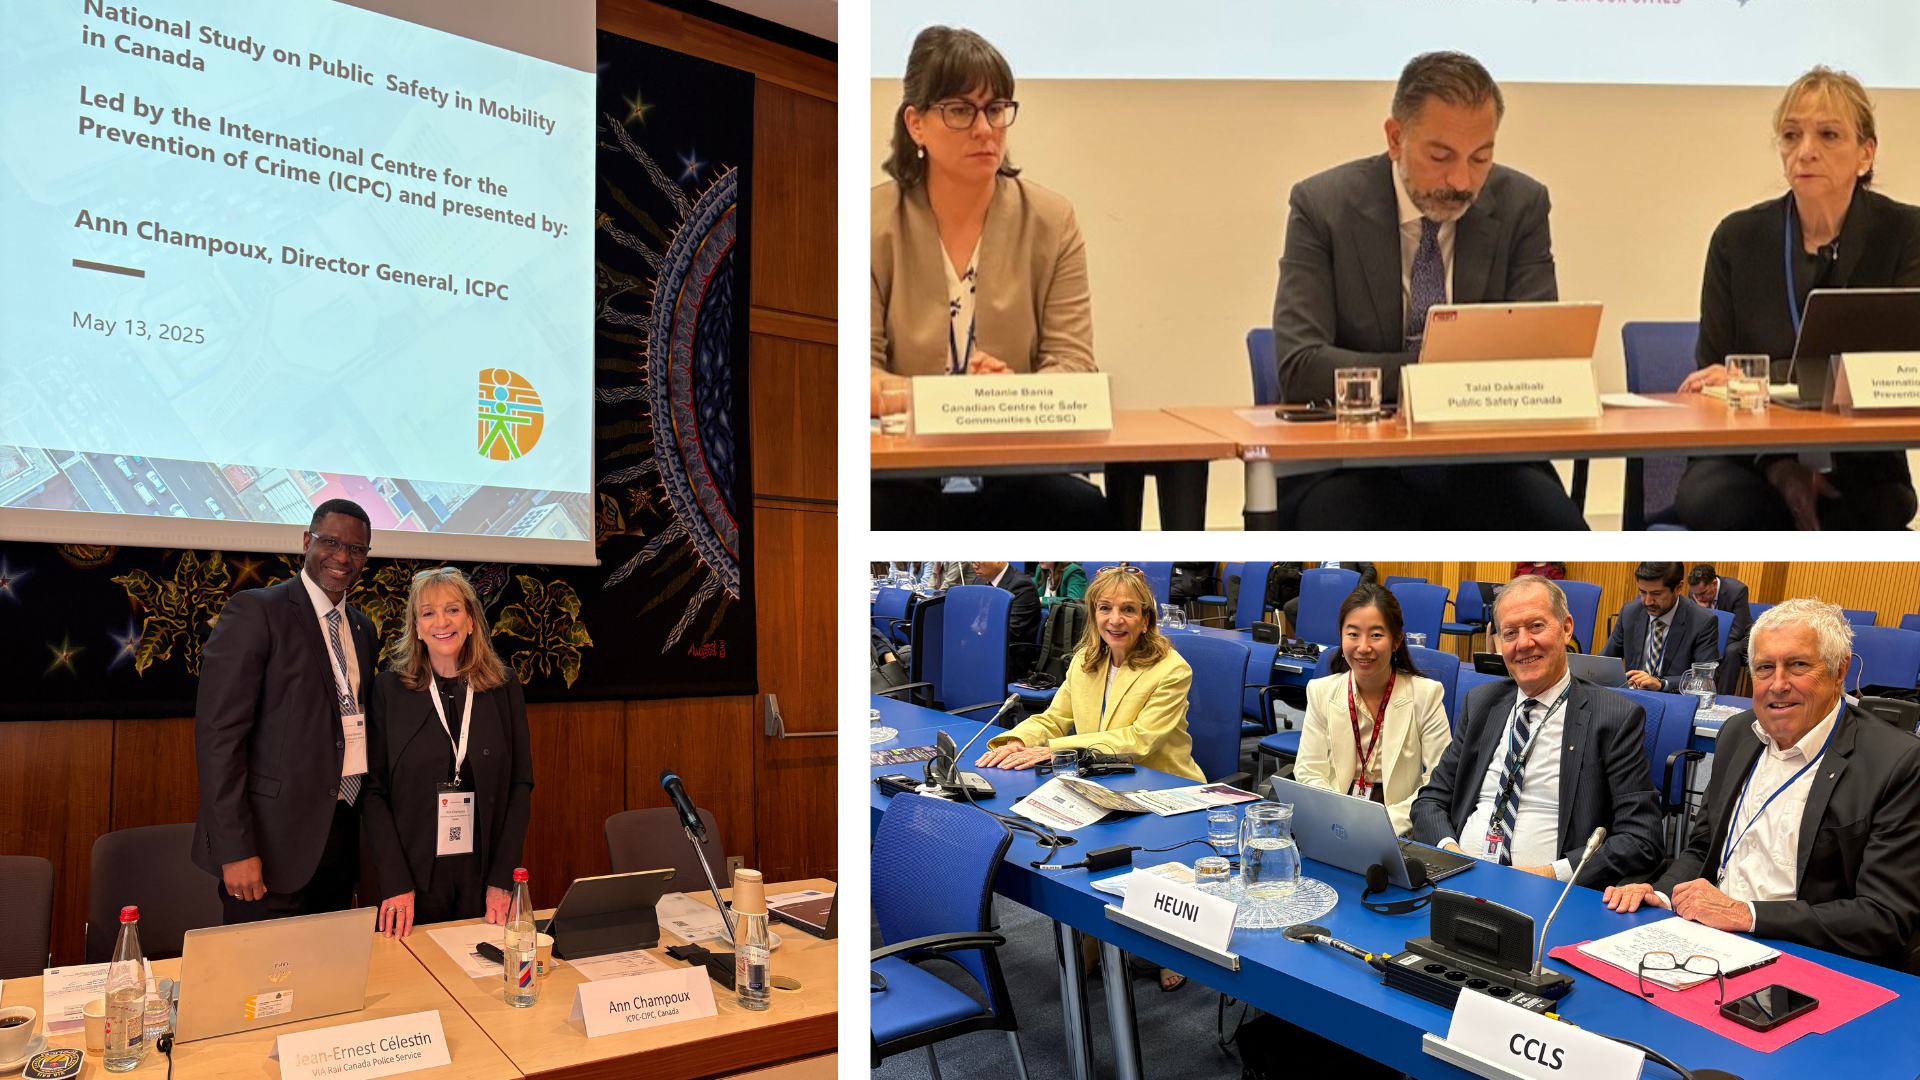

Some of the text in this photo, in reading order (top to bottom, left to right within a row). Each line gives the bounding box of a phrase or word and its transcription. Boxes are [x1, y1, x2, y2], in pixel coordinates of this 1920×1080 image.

[82, 25, 206, 72] in Canada
[83, 0, 556, 135] National Study on Public Safety in Mobility
[79, 85, 508, 198] Led by the International Centre for the
[78, 116, 569, 239] Prevention of Crime (ICPC) and presented by:
[74, 209, 509, 302] Ann Champoux, Director General, ICPC
[72, 311, 206, 346] May 13, 2025
[974, 387, 1054, 397] Melanie Bania
[1448, 395, 1563, 409] Public Safety Canada
[1465, 382, 1544, 392] Talal Dakalbab
[941, 401, 1088, 413] Canadian Centre for Safer
[956, 414, 1077, 426] Communities (CCSC)
[1153, 892, 1200, 923] HEUNI
[609, 991, 691, 1014] Ann Champoux
[625, 1007, 680, 1023] ICPC-CIPC, Canada
[295, 1032, 432, 1067] Jean-Ernest Célestin
[312, 1051, 422, 1077] VIA Rail Canada Police Service
[1509, 1033, 1565, 1071] CCLS
